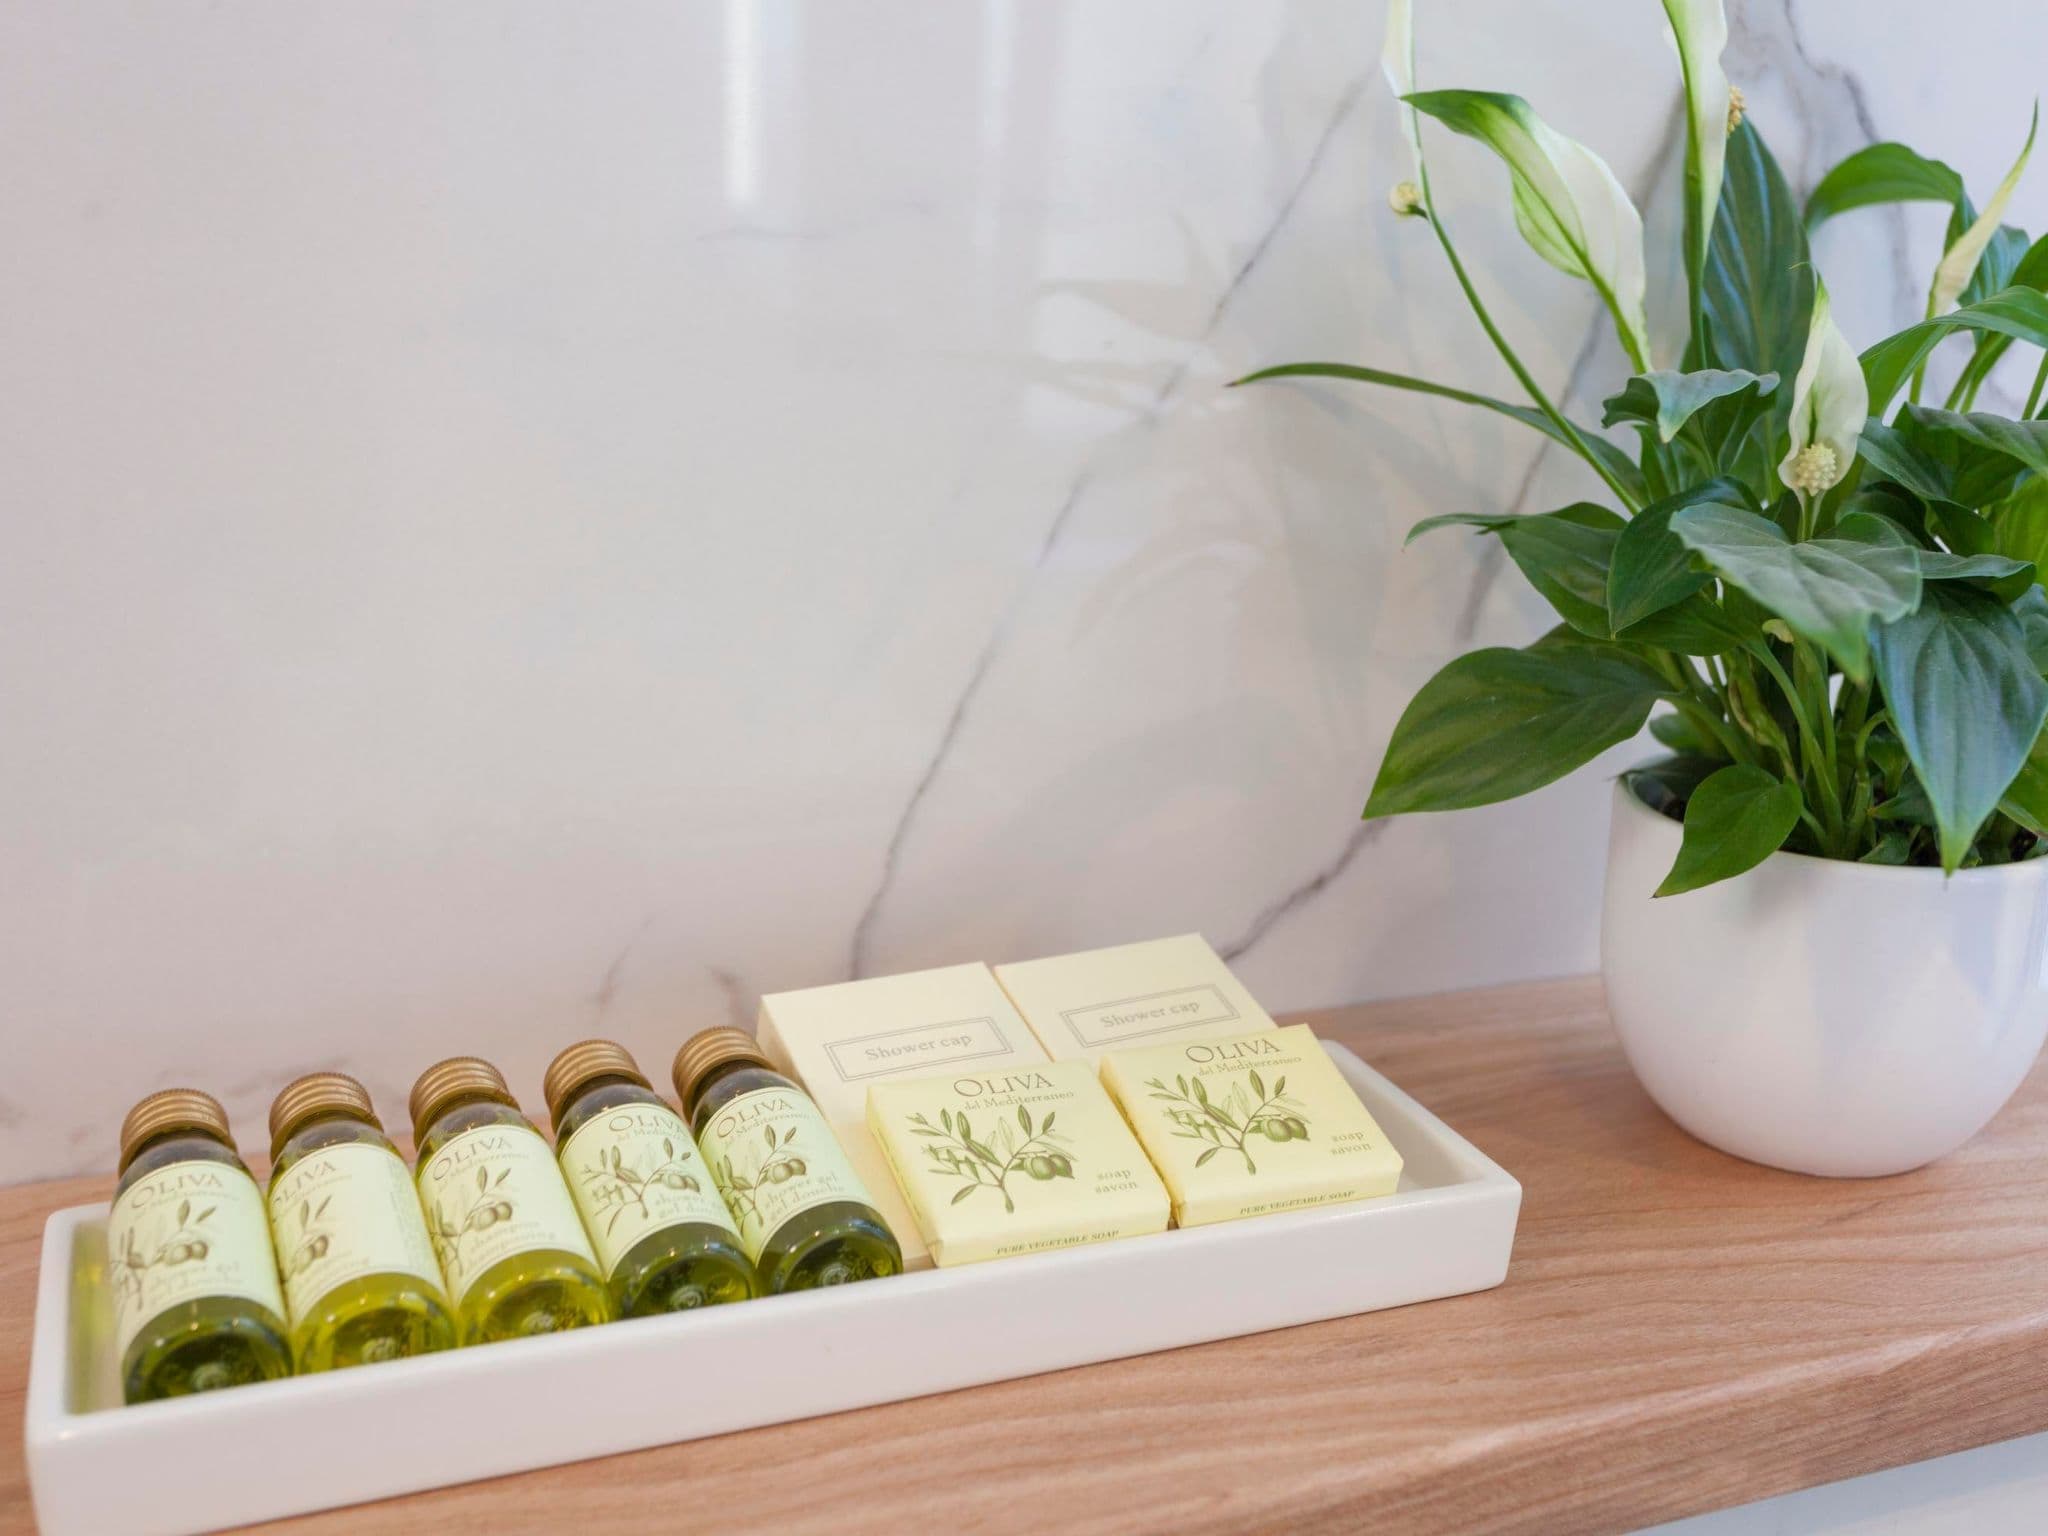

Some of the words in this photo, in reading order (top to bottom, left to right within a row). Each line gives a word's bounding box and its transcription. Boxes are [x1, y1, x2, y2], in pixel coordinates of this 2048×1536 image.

[1100, 1005, 1167, 1029] Shower
[1169, 1000, 1201, 1016] cap
[864, 1039, 936, 1062] Shower
[938, 1034, 973, 1049] cap
[1185, 1038, 1282, 1064] OLIVA
[1216, 1056, 1303, 1074] Mediterraneo
[953, 1072, 1056, 1098] OLIVA
[964, 1100, 981, 1112] del
[984, 1090, 1075, 1109] Mediterraneo
[717, 1098, 793, 1138] OLIVA
[1330, 1143, 1373, 1156] savon
[1331, 1131, 1365, 1143] soap
[432, 1137, 513, 1182] OLIVA
[1096, 1168, 1132, 1181] soap
[131, 1173, 224, 1209] OLIVA
[1095, 1181, 1138, 1194] savon
[1240, 1204, 1267, 1215] PURE
[1270, 1194, 1327, 1211] VEGETABLE
[1329, 1190, 1356, 1201] SOAP
[996, 1243, 1026, 1255] PURE
[1028, 1235, 1088, 1251] VEGETABLE
[1091, 1230, 1120, 1241] SOAP
